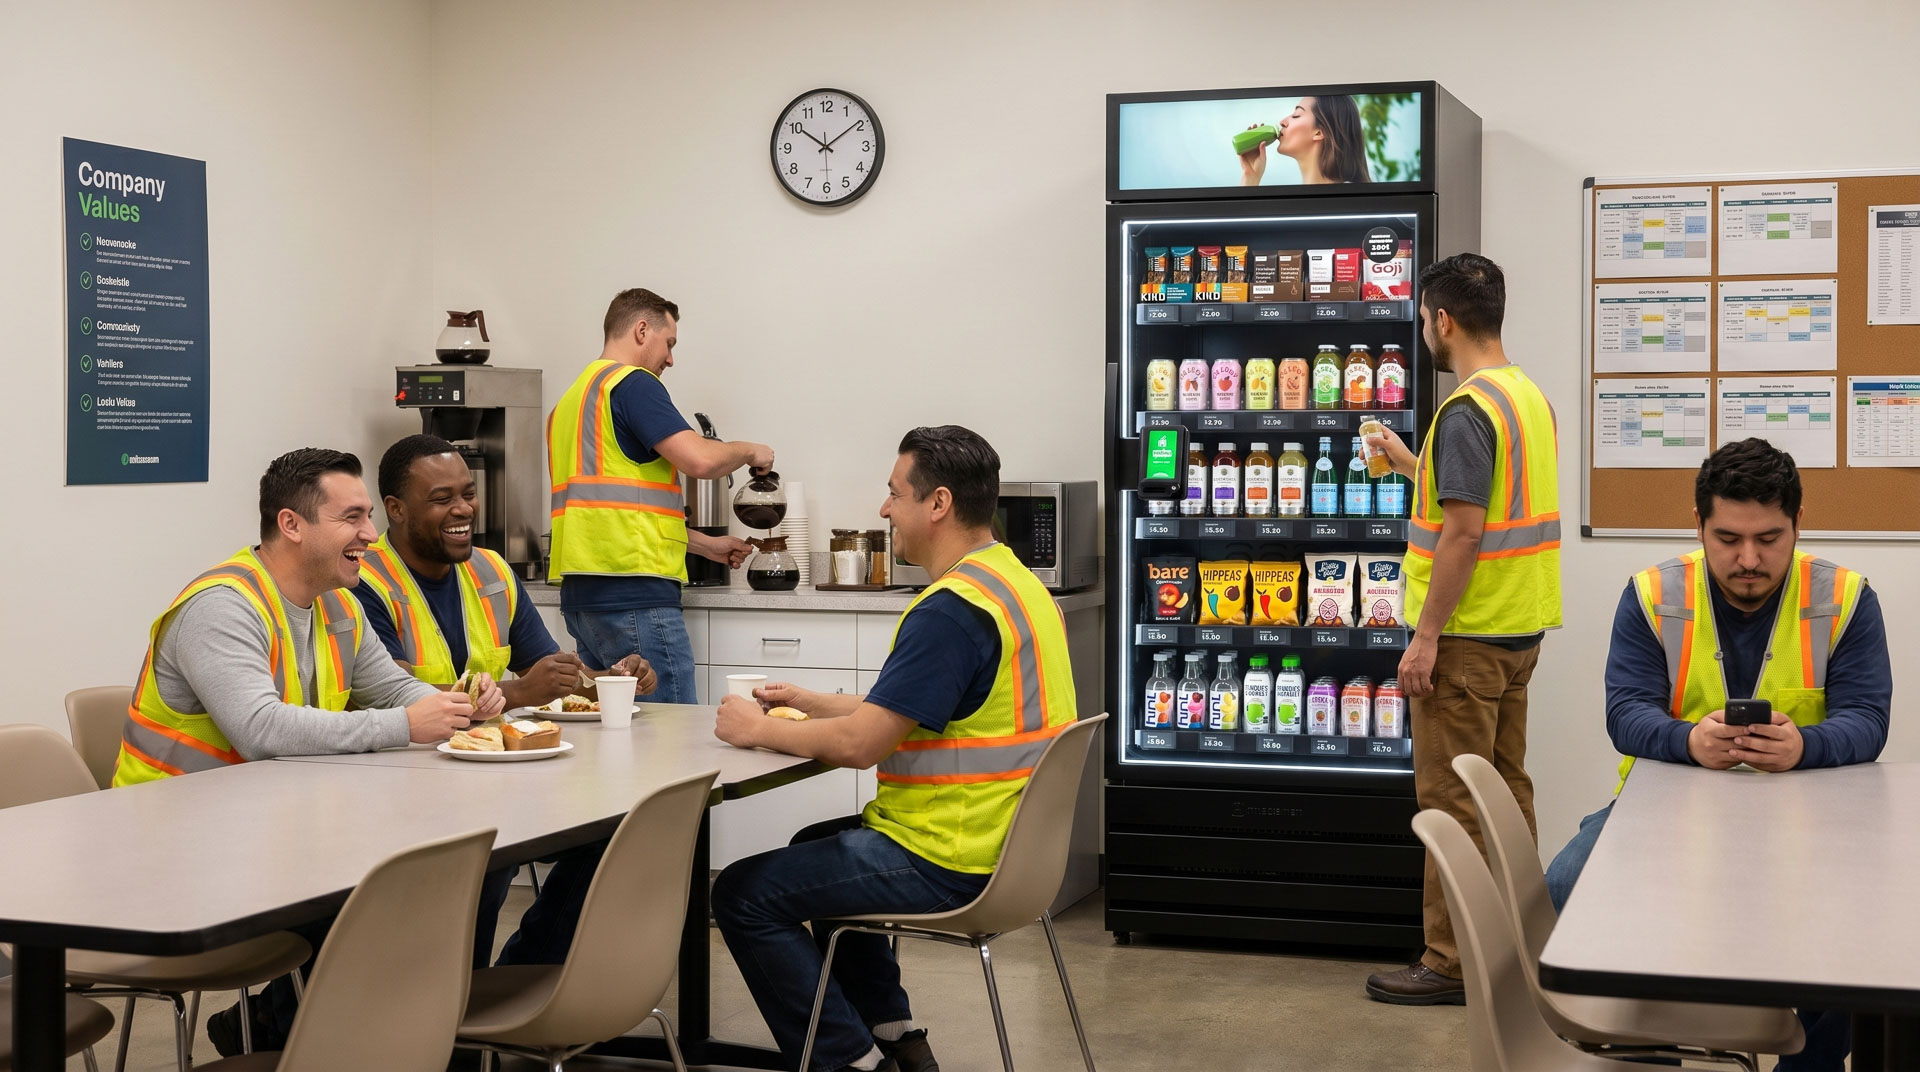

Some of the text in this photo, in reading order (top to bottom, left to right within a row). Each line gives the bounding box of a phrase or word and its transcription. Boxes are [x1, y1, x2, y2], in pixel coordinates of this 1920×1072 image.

[820, 100, 833, 113] 12
[843, 105, 849, 117] 1
[802, 107, 814, 119] 11
[789, 122, 802, 134] 10
[857, 120, 864, 131] 2
[784, 143, 791, 154] 9
[862, 141, 870, 152] 3
[790, 163, 798, 175] 8
[856, 161, 864, 172] 4
[78, 161, 166, 202] Company
[805, 177, 812, 188] 7
[822, 182, 831, 193] 6
[841, 176, 850, 188] 5
[78, 191, 141, 223] Values
[1371, 260, 1403, 277] Goji
[1147, 563, 1189, 579] bare
[1202, 569, 1242, 582] HIPPEAS
[1255, 570, 1294, 583] HIPPEAS
